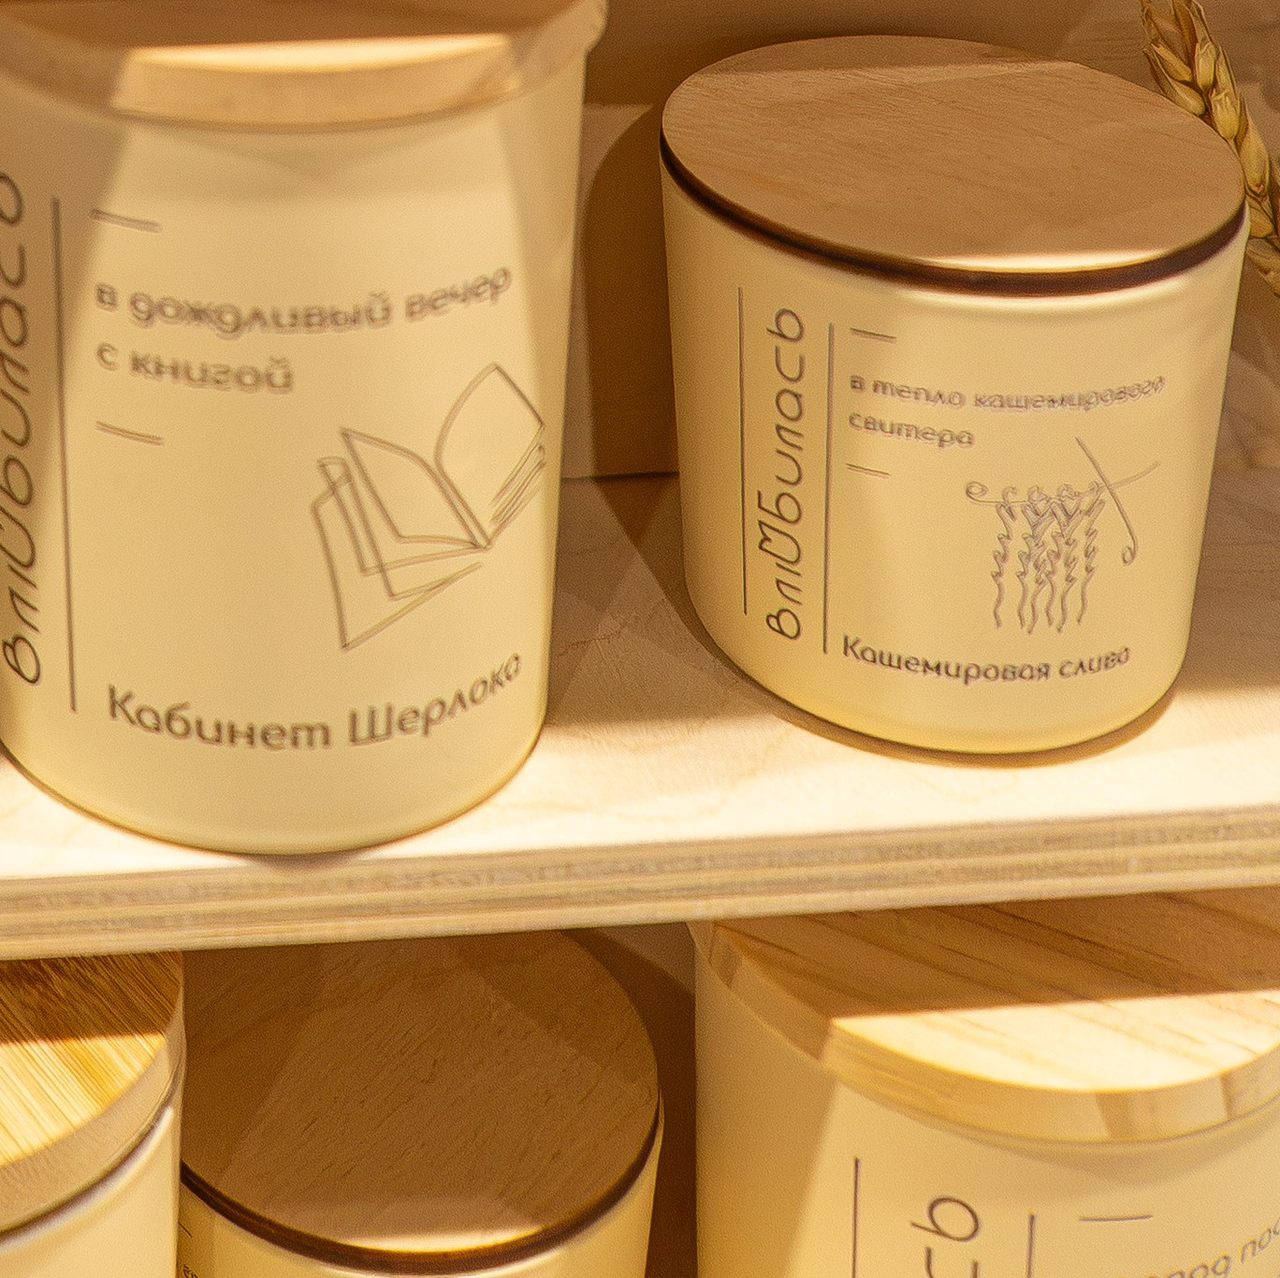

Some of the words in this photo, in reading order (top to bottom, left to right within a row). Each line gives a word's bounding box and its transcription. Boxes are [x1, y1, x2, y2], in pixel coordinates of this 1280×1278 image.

[96, 282, 118, 311] в
[129, 292, 393, 340] дождливый
[405, 265, 512, 323] вечер
[129, 353, 295, 393] книгой
[872, 379, 967, 408] тепло
[848, 411, 975, 449] свитера
[841, 635, 1052, 685] Кашемировая
[1058, 646, 1132, 679] слива
[107, 683, 333, 748] Кабинет
[346, 651, 523, 745] Шерлока
